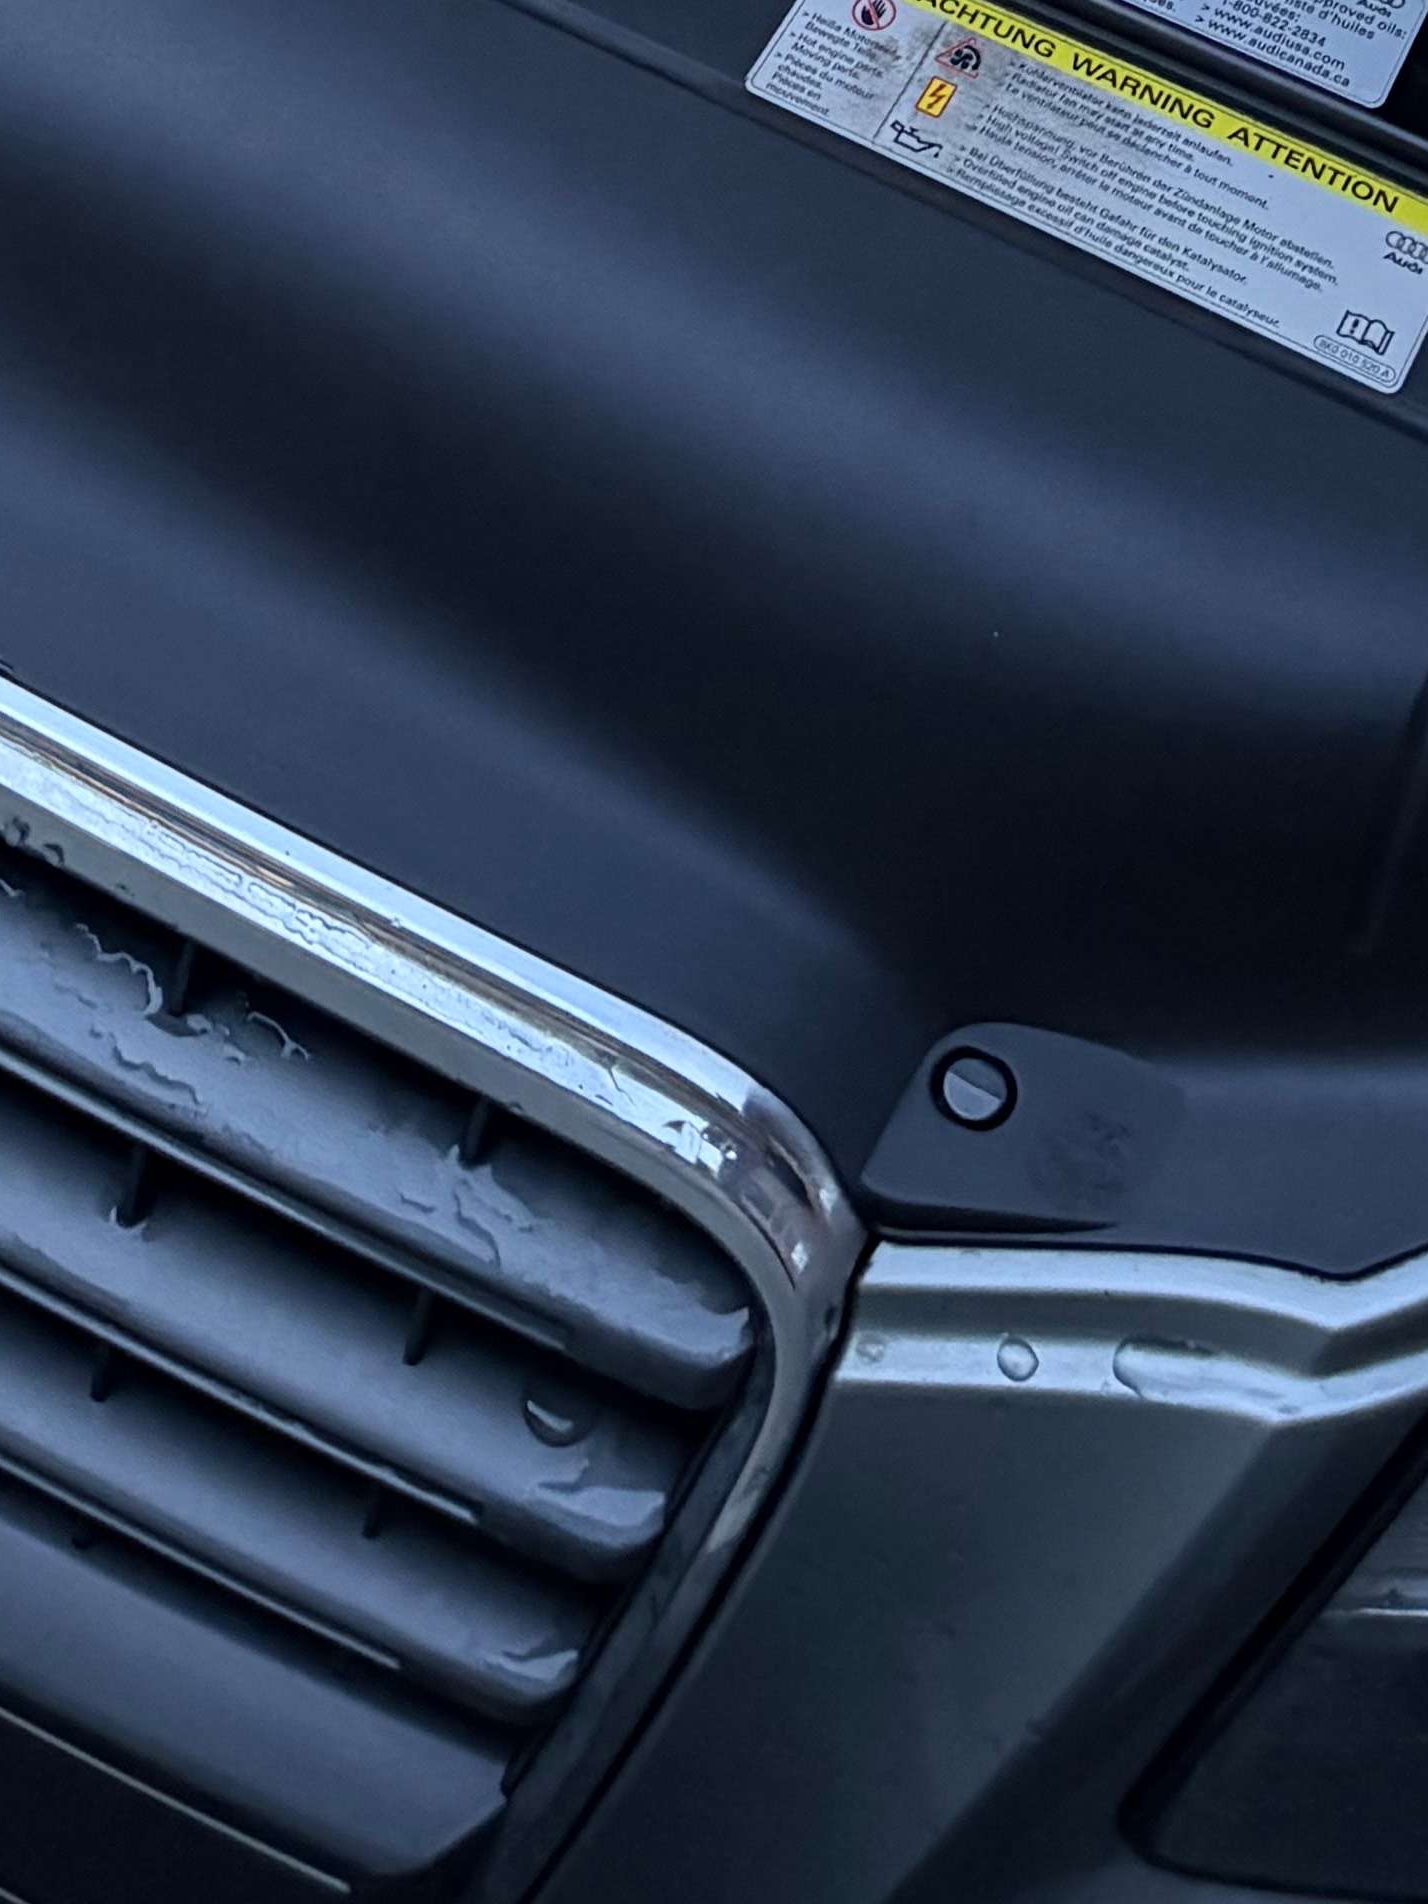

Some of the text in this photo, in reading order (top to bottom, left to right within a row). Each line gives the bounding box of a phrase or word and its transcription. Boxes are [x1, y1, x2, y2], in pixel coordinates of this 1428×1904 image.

[797, 32, 817, 48] Hot
[818, 43, 855, 65] engine
[1208, 19, 1349, 86] www.audicanada.ca
[1214, 8, 1344, 70] www.audiusa.com
[1318, 9, 1374, 39] d'huiles
[1376, 21, 1407, 39] oils:
[1072, 53, 1214, 128] WARNING
[1227, 127, 1398, 212] ATTENTION
[1103, 116, 1131, 132] start
[1131, 127, 1145, 138] at
[1143, 134, 1166, 149] any
[968, 147, 988, 161] Bei
[1055, 187, 1098, 213] besteht
[1098, 207, 1138, 232] Gefahr
[1139, 226, 1157, 241] für
[1157, 236, 1180, 252] den
[984, 114, 1012, 136] High
[1060, 148, 1098, 172] Switch
[1099, 169, 1118, 180] off
[1117, 177, 1157, 199] engine
[1158, 193, 1195, 217] before
[1195, 212, 1247, 243] touching
[1248, 236, 1293, 264] ignition
[1079, 145, 1098, 158] vor
[1151, 179, 1173, 192] der
[1241, 218, 1278, 241] Motor
[1193, 168, 1218, 186] tout
[1016, 185, 1056, 207] engine
[1056, 203, 1074, 216] oil
[1073, 211, 1095, 225] can
[1095, 222, 1142, 248] damage
[1098, 179, 1110, 192] le
[1111, 187, 1153, 211] moteur
[1153, 207, 1187, 227] avant
[1187, 223, 1203, 234] de
[1204, 230, 1249, 255] toucher
[1175, 274, 1205, 291] pour
[1205, 285, 1218, 298] le
[1383, 251, 1423, 274] Audi
